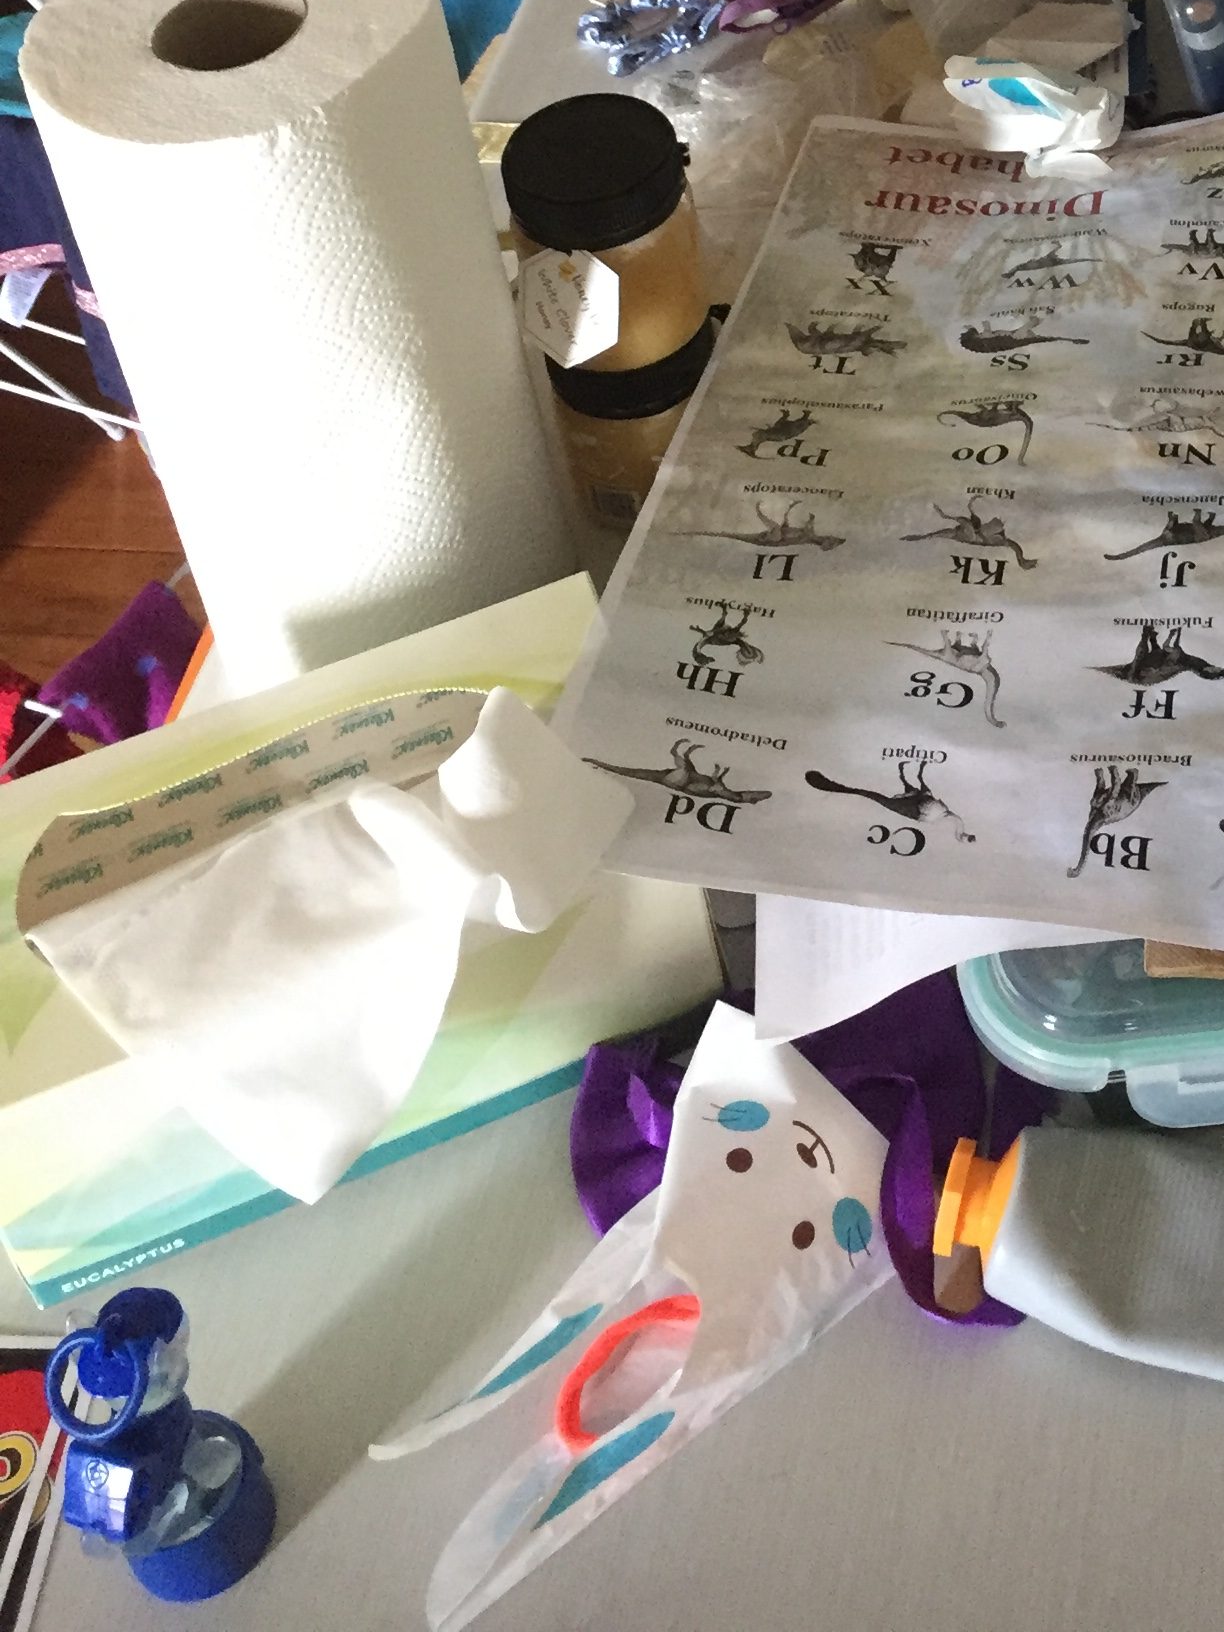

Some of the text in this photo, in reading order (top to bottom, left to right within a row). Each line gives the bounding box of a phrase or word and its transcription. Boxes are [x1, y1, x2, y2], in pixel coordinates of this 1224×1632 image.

[884, 146, 1026, 184] habet
[864, 189, 1108, 222] Dinosaur
[845, 277, 897, 297] Xx
[1006, 273, 1079, 291] Ww
[556, 306, 579, 345] Clover
[807, 355, 857, 375] Tt
[989, 353, 1031, 372] Ss
[1156, 351, 1206, 367] Rr
[776, 439, 832, 468] Pp
[951, 443, 1010, 466] Oo
[1156, 442, 1217, 467] Nn
[966, 485, 1017, 502] Khaan
[752, 552, 800, 582] Ll
[949, 555, 1010, 587] Kk
[1158, 552, 1196, 589] Jj
[905, 607, 1005, 624] Giraffatitan
[1112, 615, 1213, 629] Fukuisaurus
[675, 662, 744, 699] Hh
[903, 671, 975, 709] Gg
[1121, 689, 1179, 721] Ff
[665, 716, 788, 751] Deltadromeus
[881, 745, 949, 766] Citipati
[1070, 754, 1193, 767] Brachiosaurus
[663, 794, 742, 836] Dd
[866, 824, 927, 858] Cc
[1090, 832, 1153, 872] Bb
[61, 1238, 186, 1293] EUCALYPTUS
